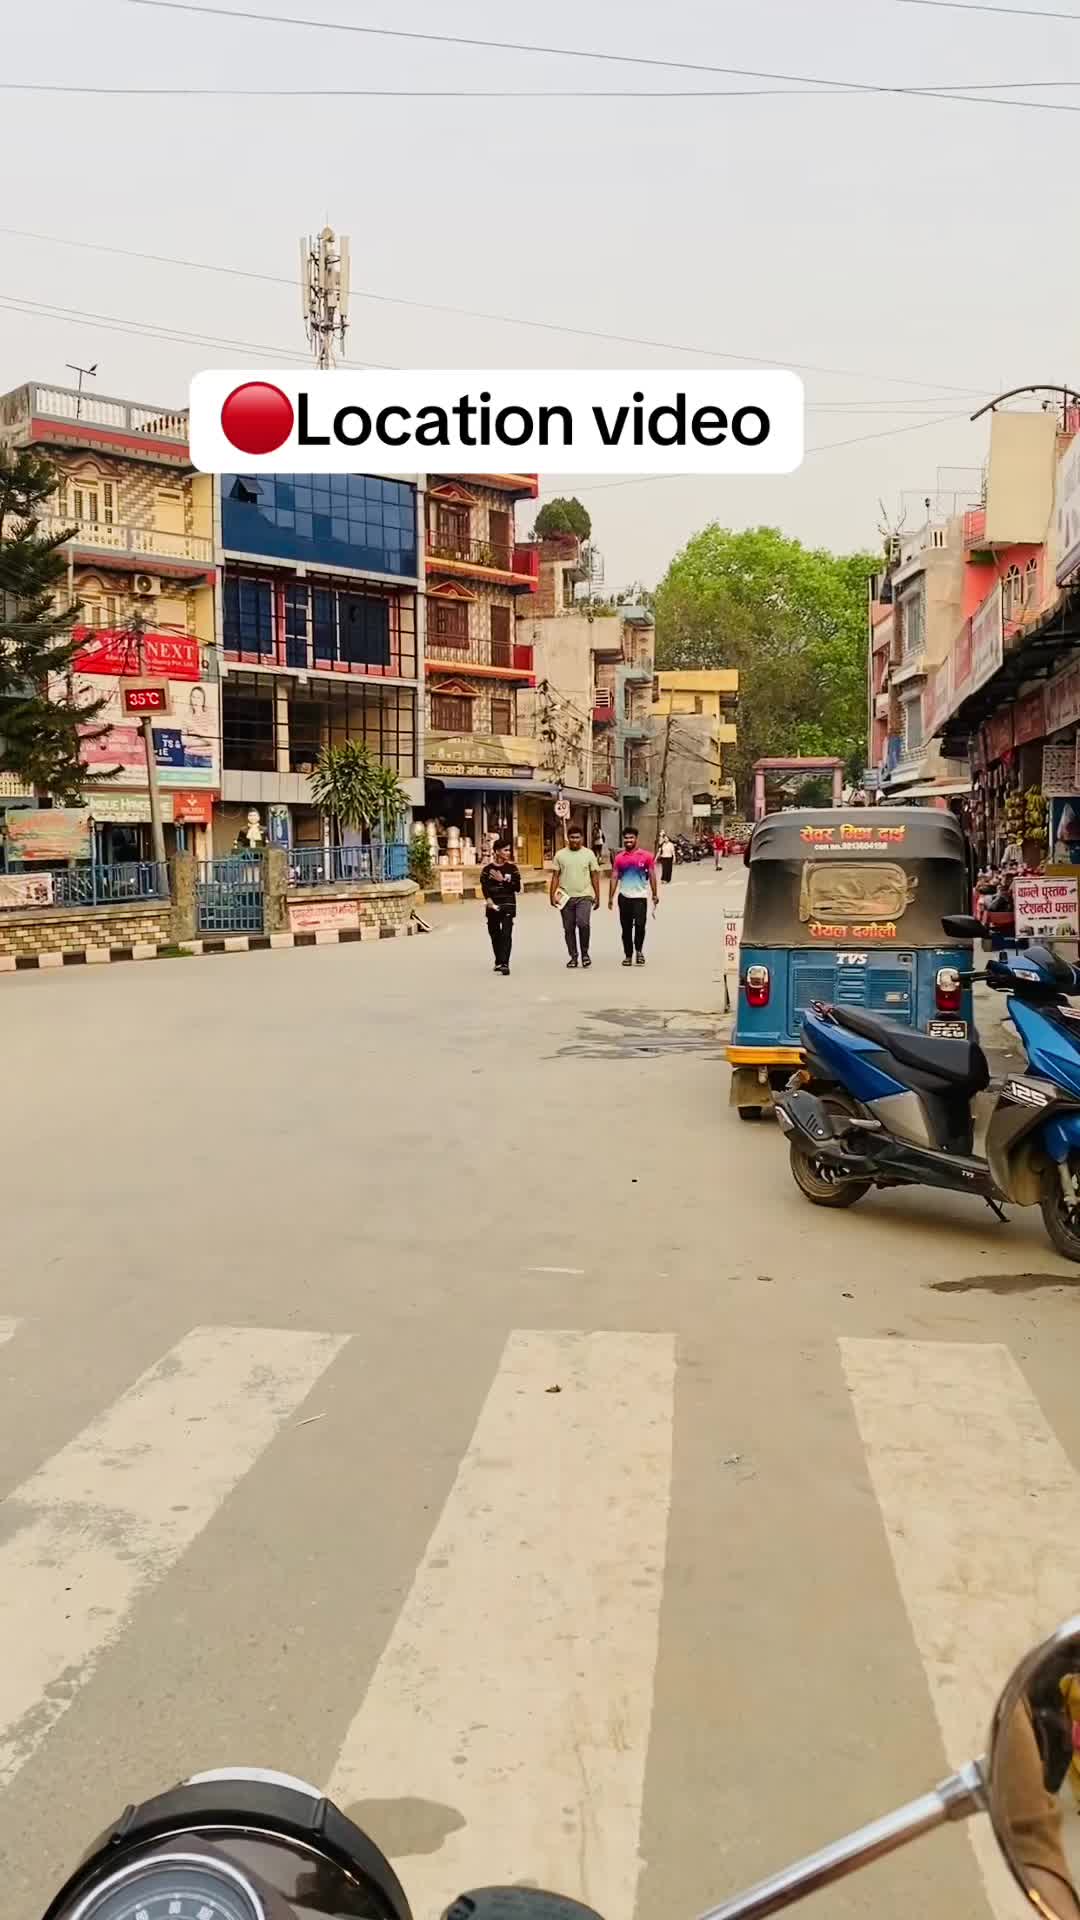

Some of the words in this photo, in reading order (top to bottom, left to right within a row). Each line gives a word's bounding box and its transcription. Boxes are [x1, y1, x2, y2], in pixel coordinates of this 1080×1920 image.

[147, 640, 194, 660] NEXT
[1042, 886, 1068, 900] पुस्तक
[1019, 900, 1053, 915] स्टेशनरी
[1055, 902, 1077, 913] पसल
[836, 953, 869, 965] TVS
[1011, 1081, 1048, 1107] 125
